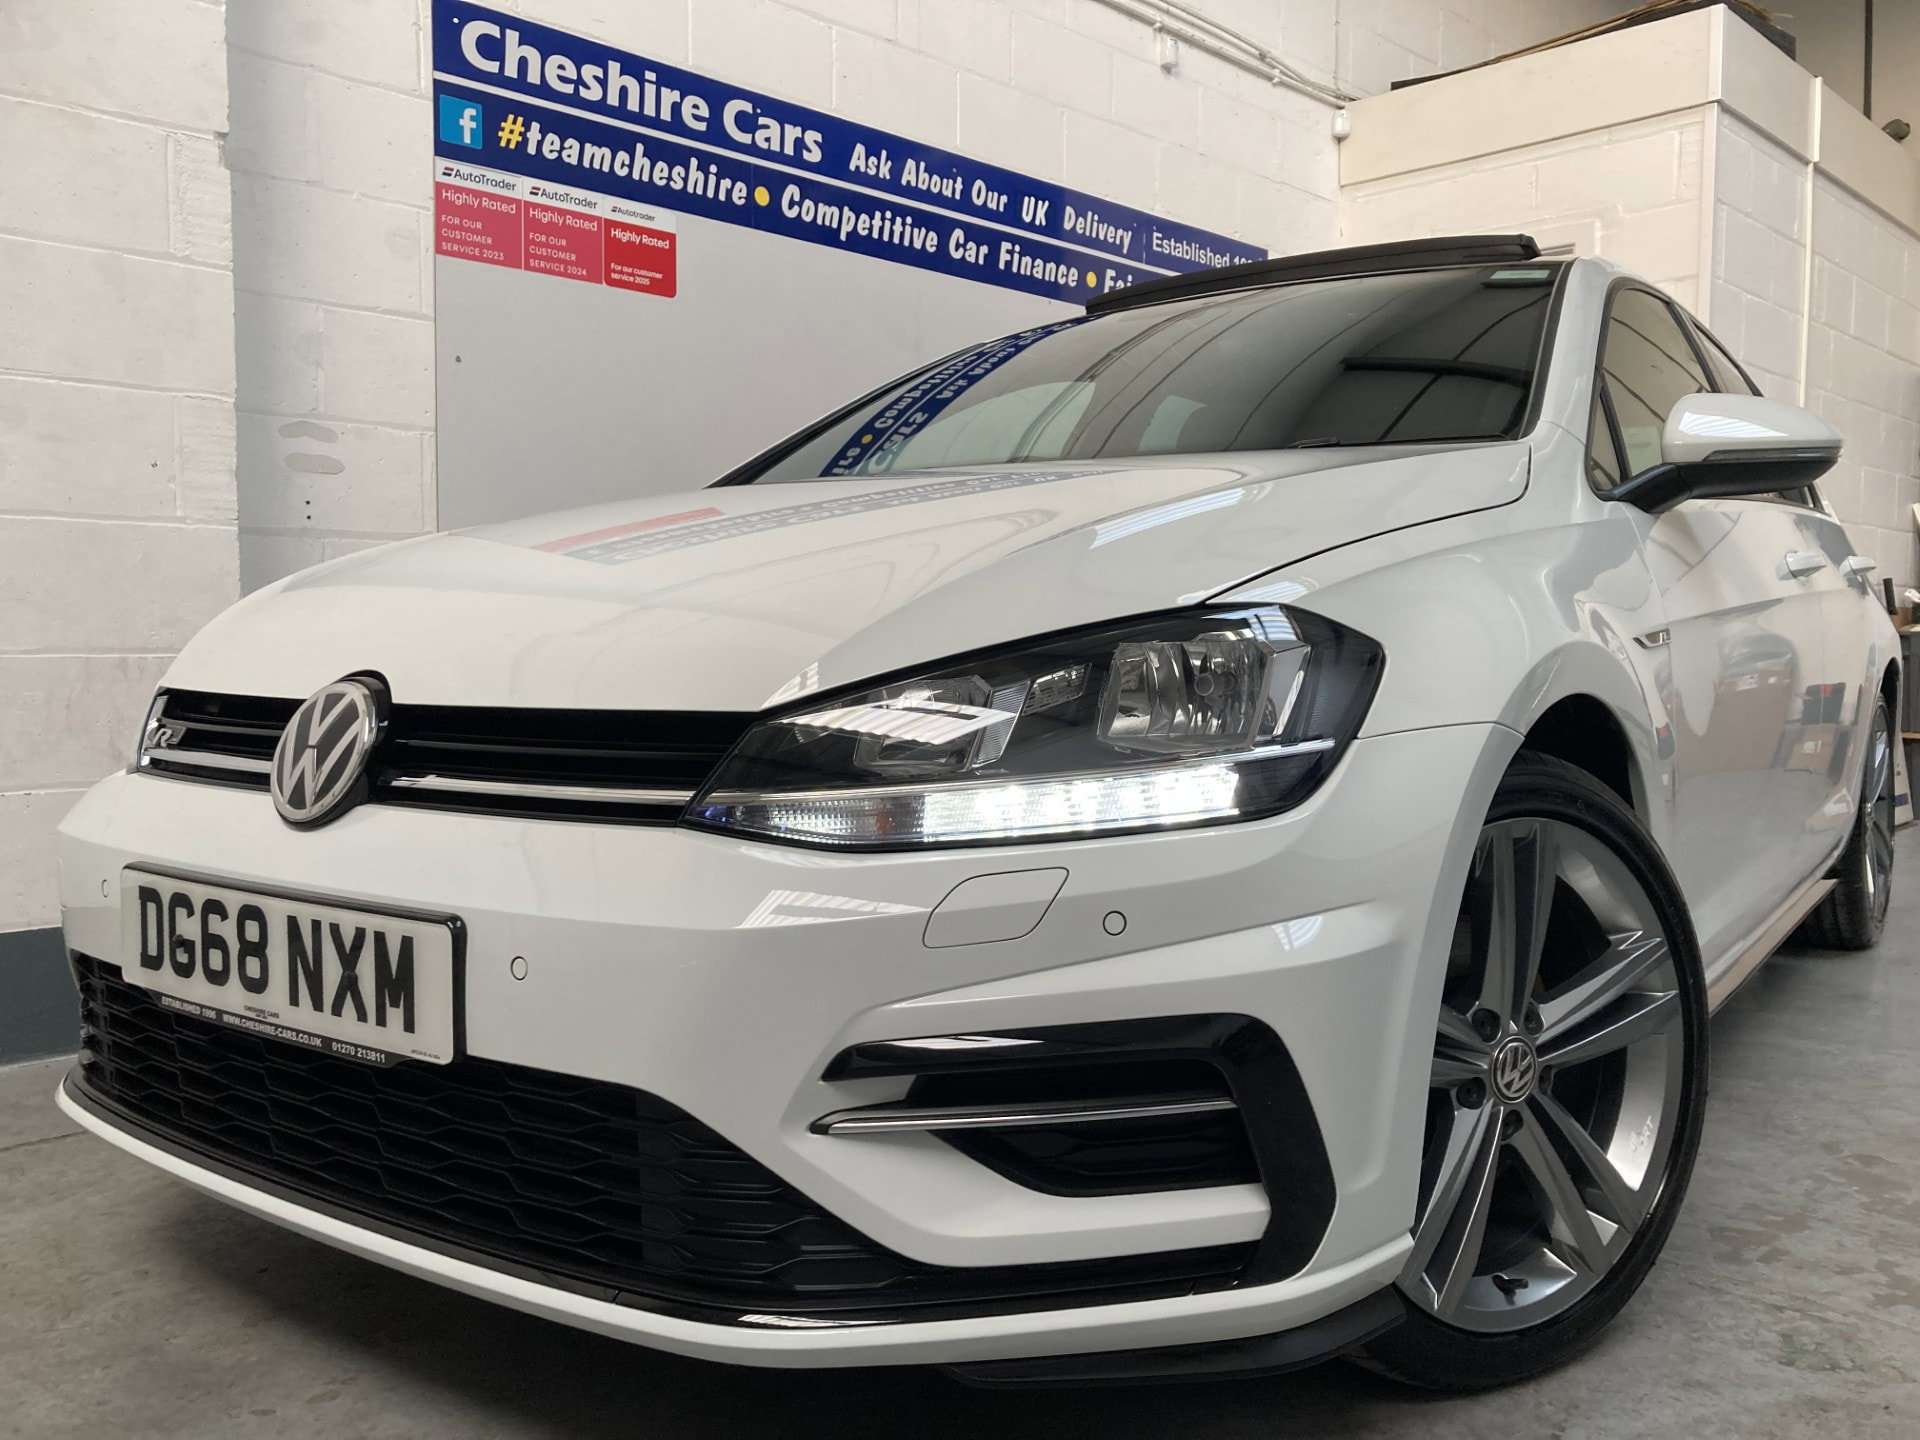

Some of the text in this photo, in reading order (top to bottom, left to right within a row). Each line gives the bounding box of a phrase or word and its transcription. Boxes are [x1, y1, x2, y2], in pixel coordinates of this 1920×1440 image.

[460, 19, 824, 163] Cheshire Cars
[498, 113, 747, 206] #teamcheshire
[454, 168, 517, 192] AutoTrader
[442, 189, 516, 215] Highly Rated
[540, 188, 598, 210] AutoTrader
[849, 142, 1133, 254] Ask About Our UK Delivery
[442, 214, 483, 230] FOR OUR
[529, 207, 598, 232] Highly Rated
[442, 228, 493, 245] CUSTOMER
[529, 232, 567, 247] FOR OUR
[611, 227, 670, 249] Highly Rated
[780, 183, 1080, 287] Competitive Car Finance
[442, 242, 481, 257] SERVICE
[529, 246, 576, 262] CUSTOMER
[1152, 231, 1230, 268] Established
[529, 258, 588, 277] SERVICE 2024
[611, 262, 664, 279] For our customer
[611, 272, 633, 284] service
[138, 885, 416, 1035] DG68 NXM
[331, 1041, 355, 1056] 01270
